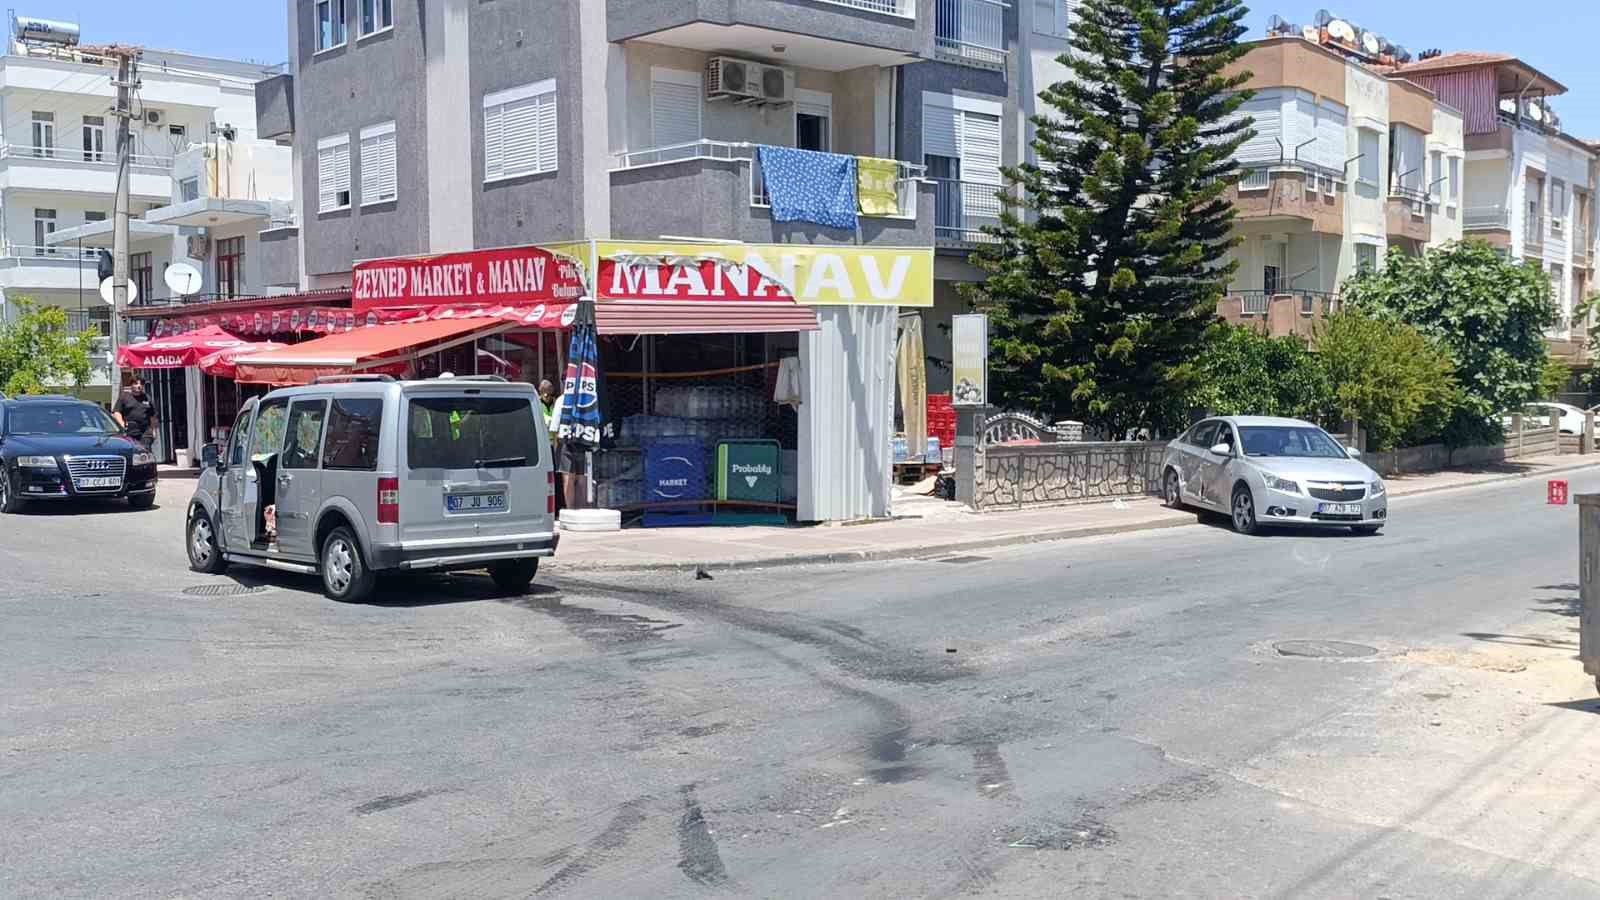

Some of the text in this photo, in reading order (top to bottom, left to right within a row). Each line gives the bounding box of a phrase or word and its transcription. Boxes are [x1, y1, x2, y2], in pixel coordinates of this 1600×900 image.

[355, 257, 546, 299] ZEYNEP MARKET & MANAV
[143, 355, 182, 366] ALGIDA
[732, 464, 772, 475] Probably
[487, 495, 502, 506] 906
